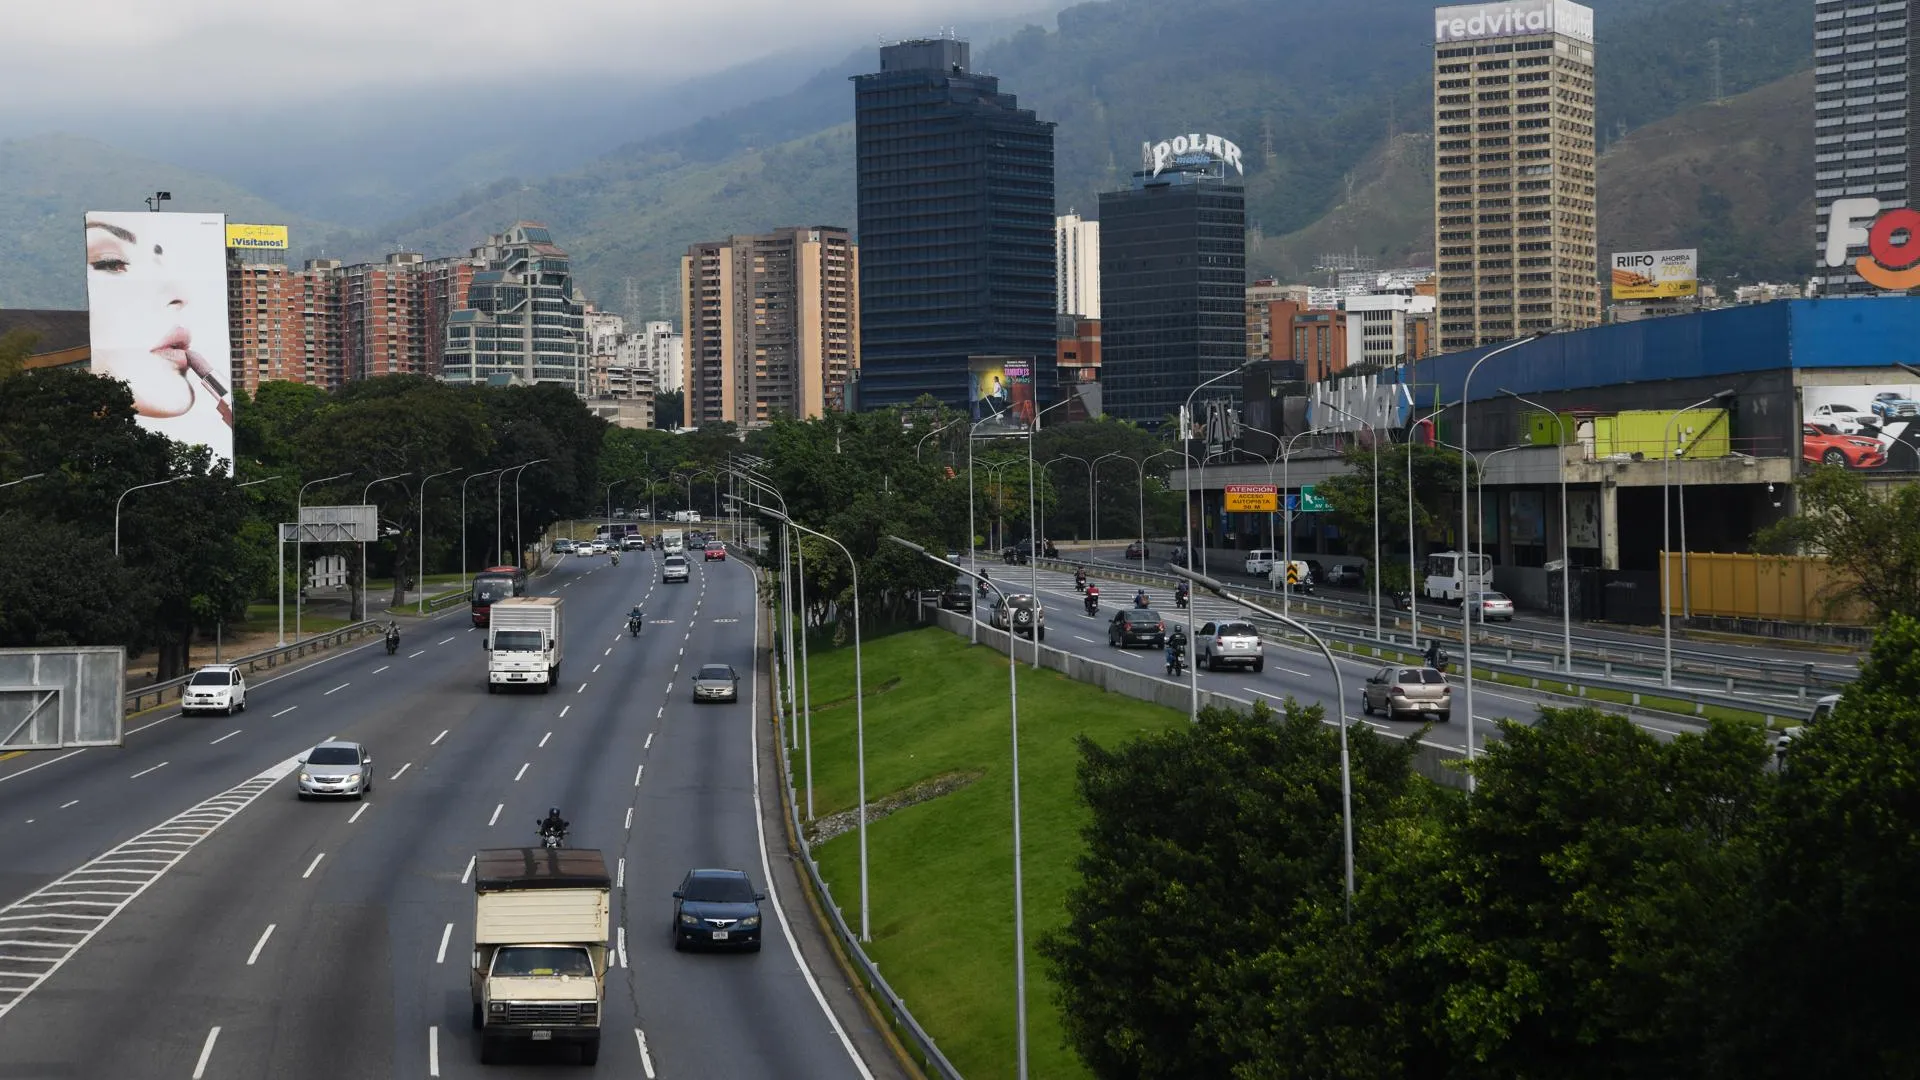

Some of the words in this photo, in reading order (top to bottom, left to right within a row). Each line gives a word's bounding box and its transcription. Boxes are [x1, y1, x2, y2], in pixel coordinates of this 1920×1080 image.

[1436, 2, 1553, 38] redvital
[1153, 133, 1243, 178] POLAR
[1617, 255, 1654, 267] RIIFO
[1661, 264, 1693, 276] 70%
